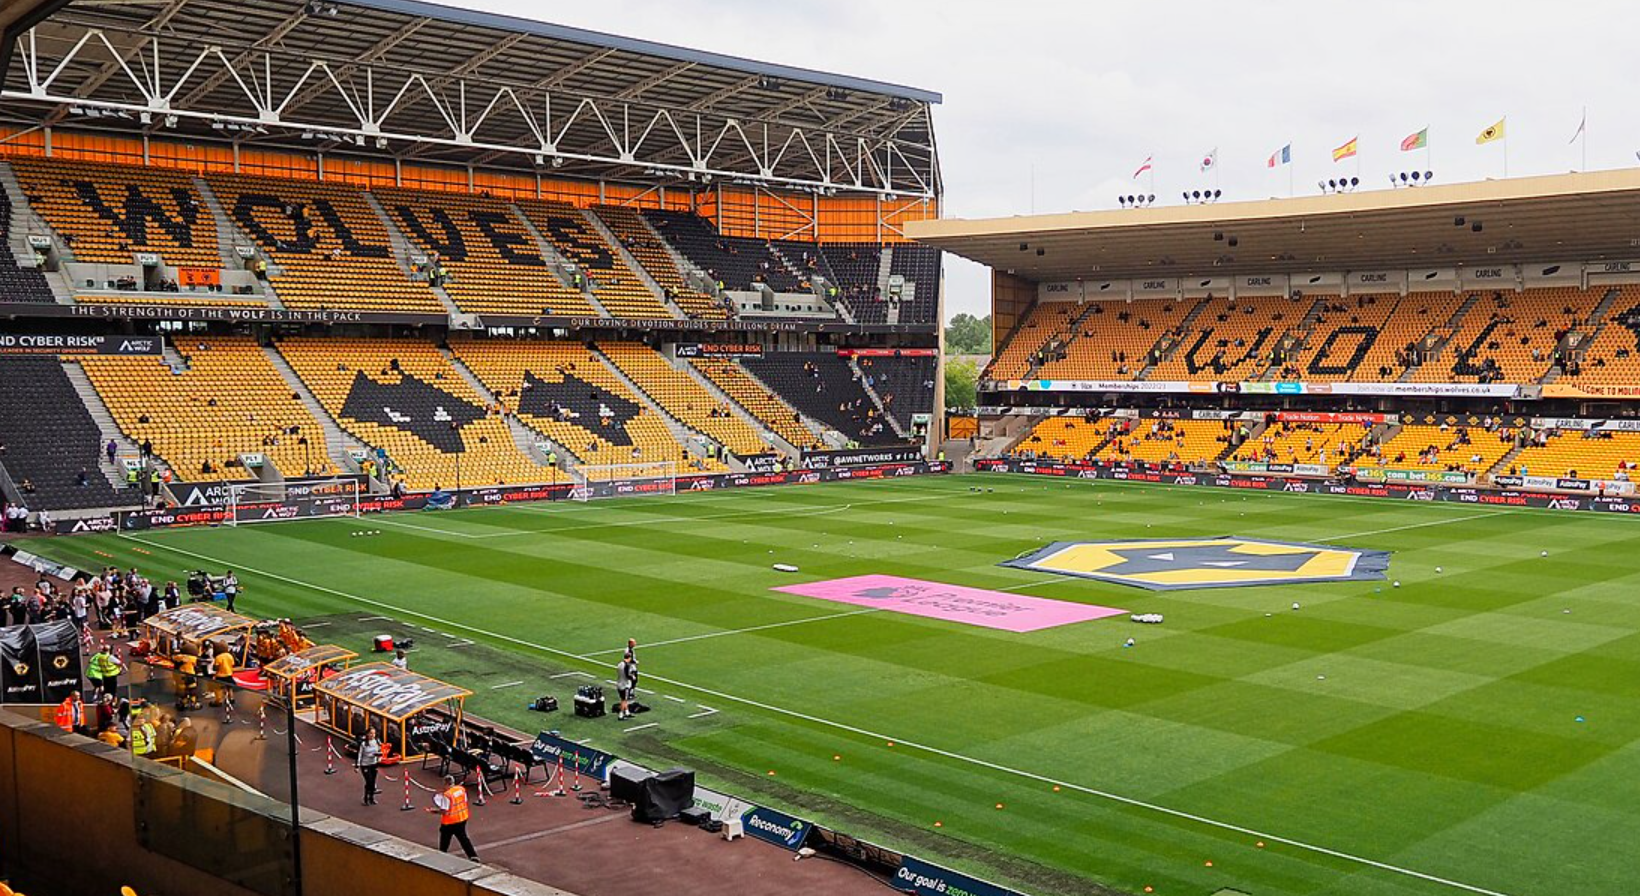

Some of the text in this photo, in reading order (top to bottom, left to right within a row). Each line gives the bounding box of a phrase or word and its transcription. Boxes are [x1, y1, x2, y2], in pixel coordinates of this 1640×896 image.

[1604, 263, 1631, 271] CARLING
[1361, 273, 1387, 282] CARLING
[1475, 269, 1502, 278] CARLING
[1143, 281, 1165, 290] CARLING
[1247, 277, 1271, 287] CARLING
[1046, 284, 1068, 293] CARLING
[70, 306, 362, 322] THE STRENGTH OF THE WOLF IS IN THE PACK
[571, 318, 796, 331] OUR LOVING DEVOTION GUIDES OUR LIFELONG DREAM
[24, 336, 66, 348] CYBER
[68, 337, 98, 348] RISK
[703, 345, 761, 353] END CYBER RISK
[1099, 383, 1139, 391] Memberships
[1395, 385, 1491, 396] memberships.wolves.co.uk
[1607, 387, 1616, 396] TO
[754, 456, 775, 465] ARCTIC
[811, 454, 830, 462] ARCTIC
[833, 452, 893, 466] @AWNETWORKS
[1036, 467, 1053, 475] CYBER
[1227, 463, 1267, 471] et365.com
[851, 469, 869, 478] CYBER
[869, 468, 884, 476] RISK
[1128, 473, 1146, 481] CYBER
[1147, 474, 1161, 482] RISK
[1409, 471, 1466, 483] bet365.com
[749, 476, 770, 485] CYBER
[770, 475, 786, 483] RISK
[1216, 479, 1268, 489] END CYBER RISK
[205, 484, 246, 497] ARCTIC
[311, 485, 344, 495] CYBER
[634, 484, 657, 492] CYBER
[658, 483, 675, 491] RISK
[1330, 486, 1346, 494] END
[1347, 487, 1370, 496] CYBER
[1371, 489, 1388, 497] RISK
[484, 494, 502, 502] END
[503, 492, 529, 501] CYBER
[530, 491, 549, 499] RISK
[1460, 495, 1478, 503] END
[1479, 495, 1506, 505] CYBER
[1507, 497, 1527, 506] RISK
[330, 504, 351, 512] END
[383, 499, 404, 509] RISK
[1609, 504, 1630, 513] END
[151, 515, 175, 524] END
[176, 512, 212, 522] CYBER
[338, 669, 436, 713] AstroPay
[411, 721, 453, 736] AstroPay
[748, 814, 795, 841] Reconomy
[898, 867, 917, 883] Our
[914, 875, 938, 890] goal
[936, 879, 947, 893] is
